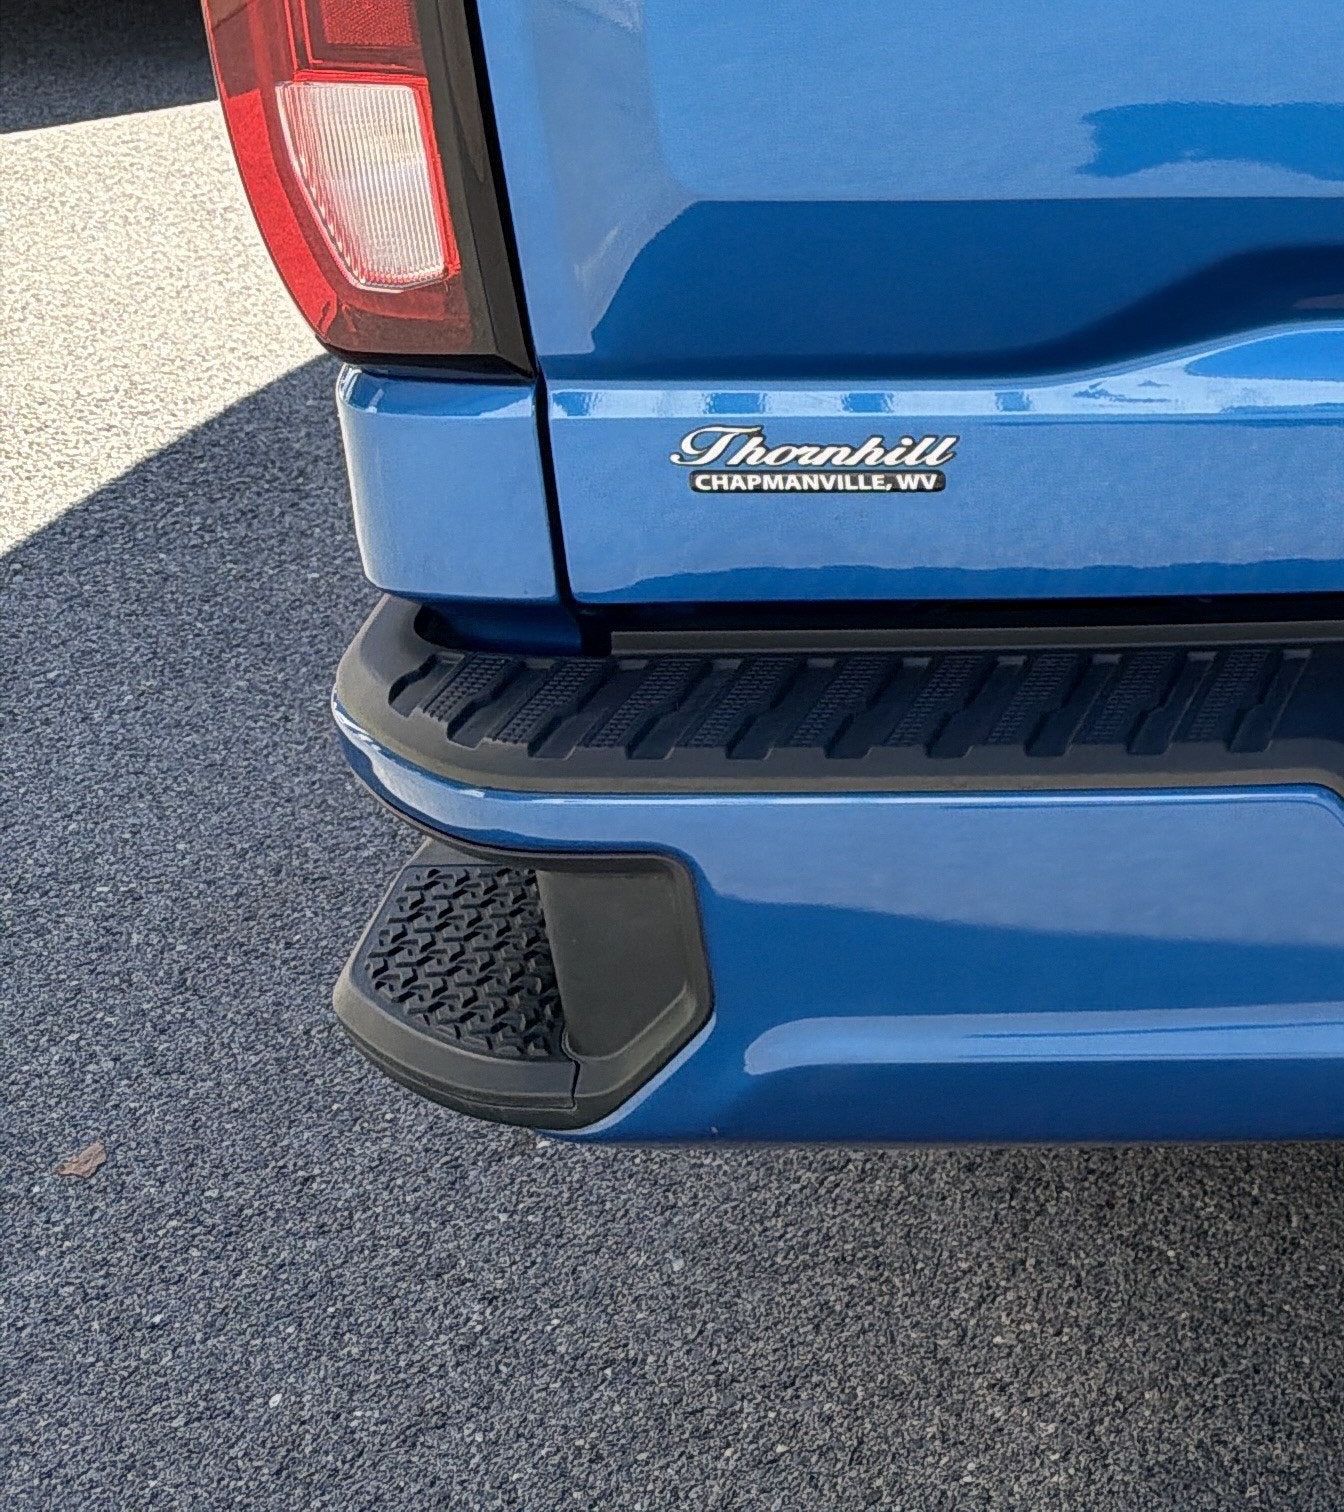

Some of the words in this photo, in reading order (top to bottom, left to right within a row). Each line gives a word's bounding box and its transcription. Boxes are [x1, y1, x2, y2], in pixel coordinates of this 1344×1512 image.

[669, 424, 958, 467] Thornhill
[694, 474, 893, 491] CHAPMANVILLE,
[897, 474, 938, 490] WV
